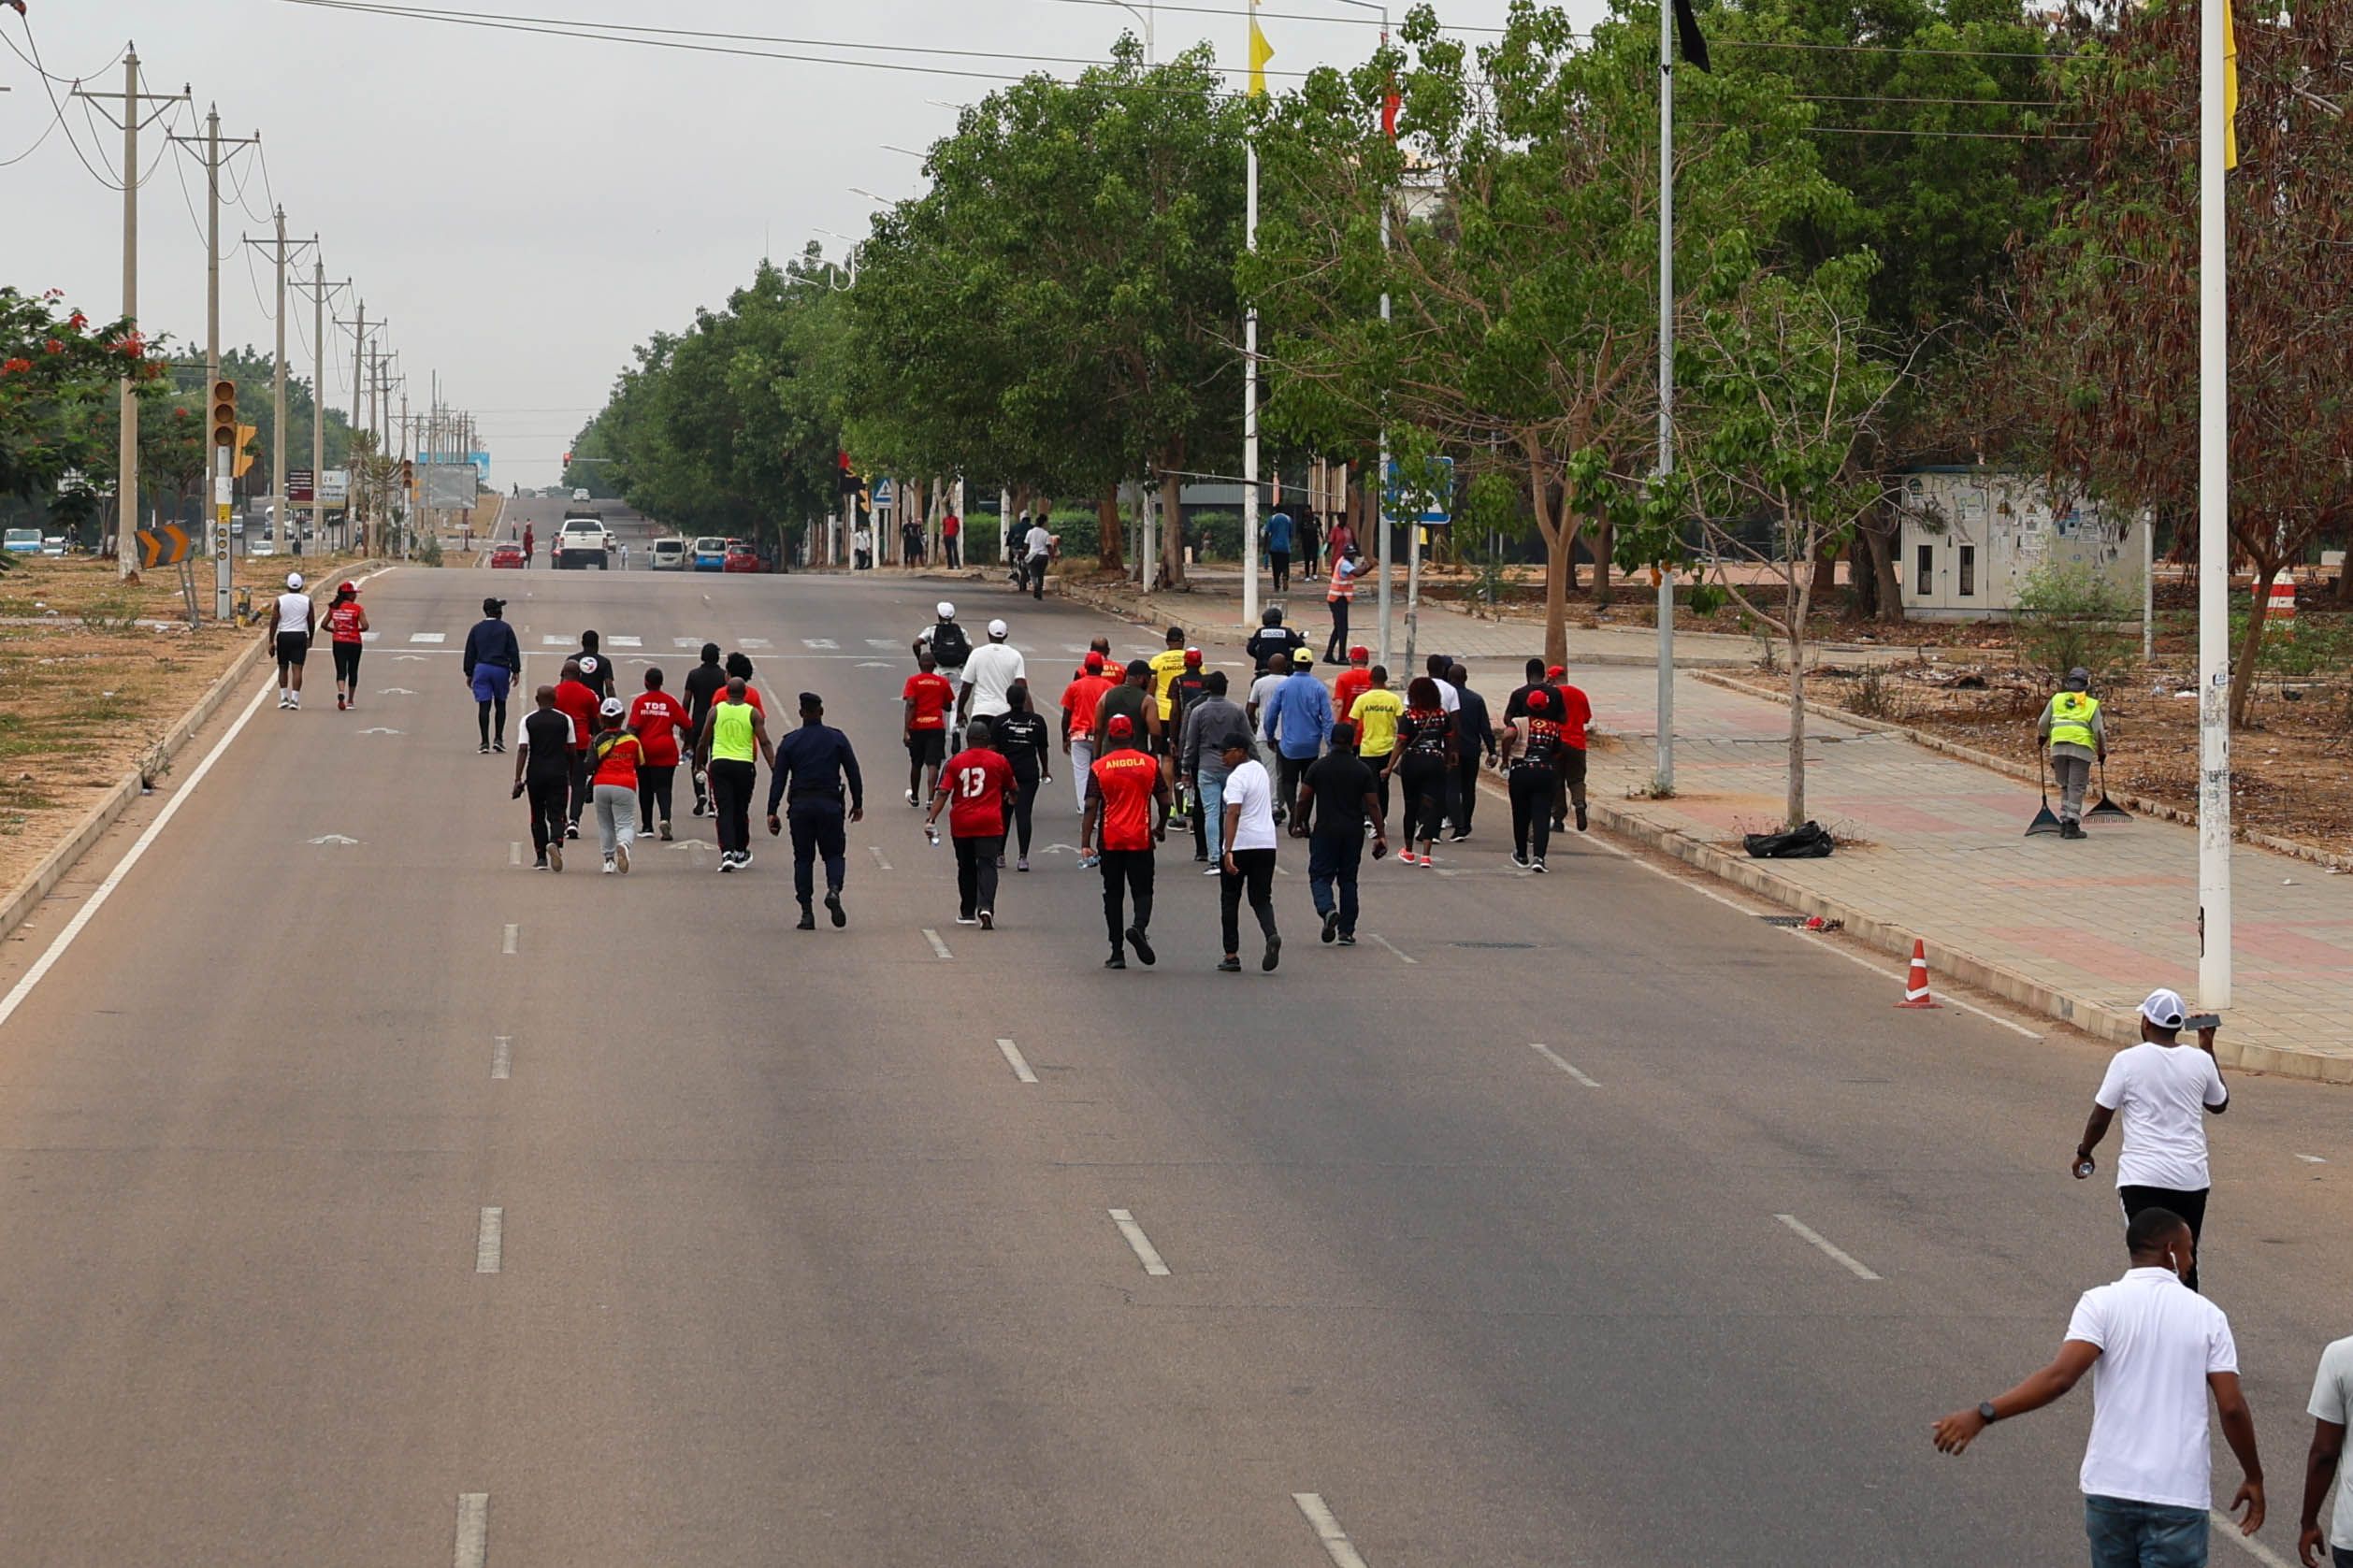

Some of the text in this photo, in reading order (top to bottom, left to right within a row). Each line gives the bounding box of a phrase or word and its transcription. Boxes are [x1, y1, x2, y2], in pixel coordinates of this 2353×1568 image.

[643, 702, 667, 711] TDS
[1364, 704, 1393, 712] ANGOLA
[1105, 757, 1146, 770] ANGOLA
[959, 767, 986, 798] 13
